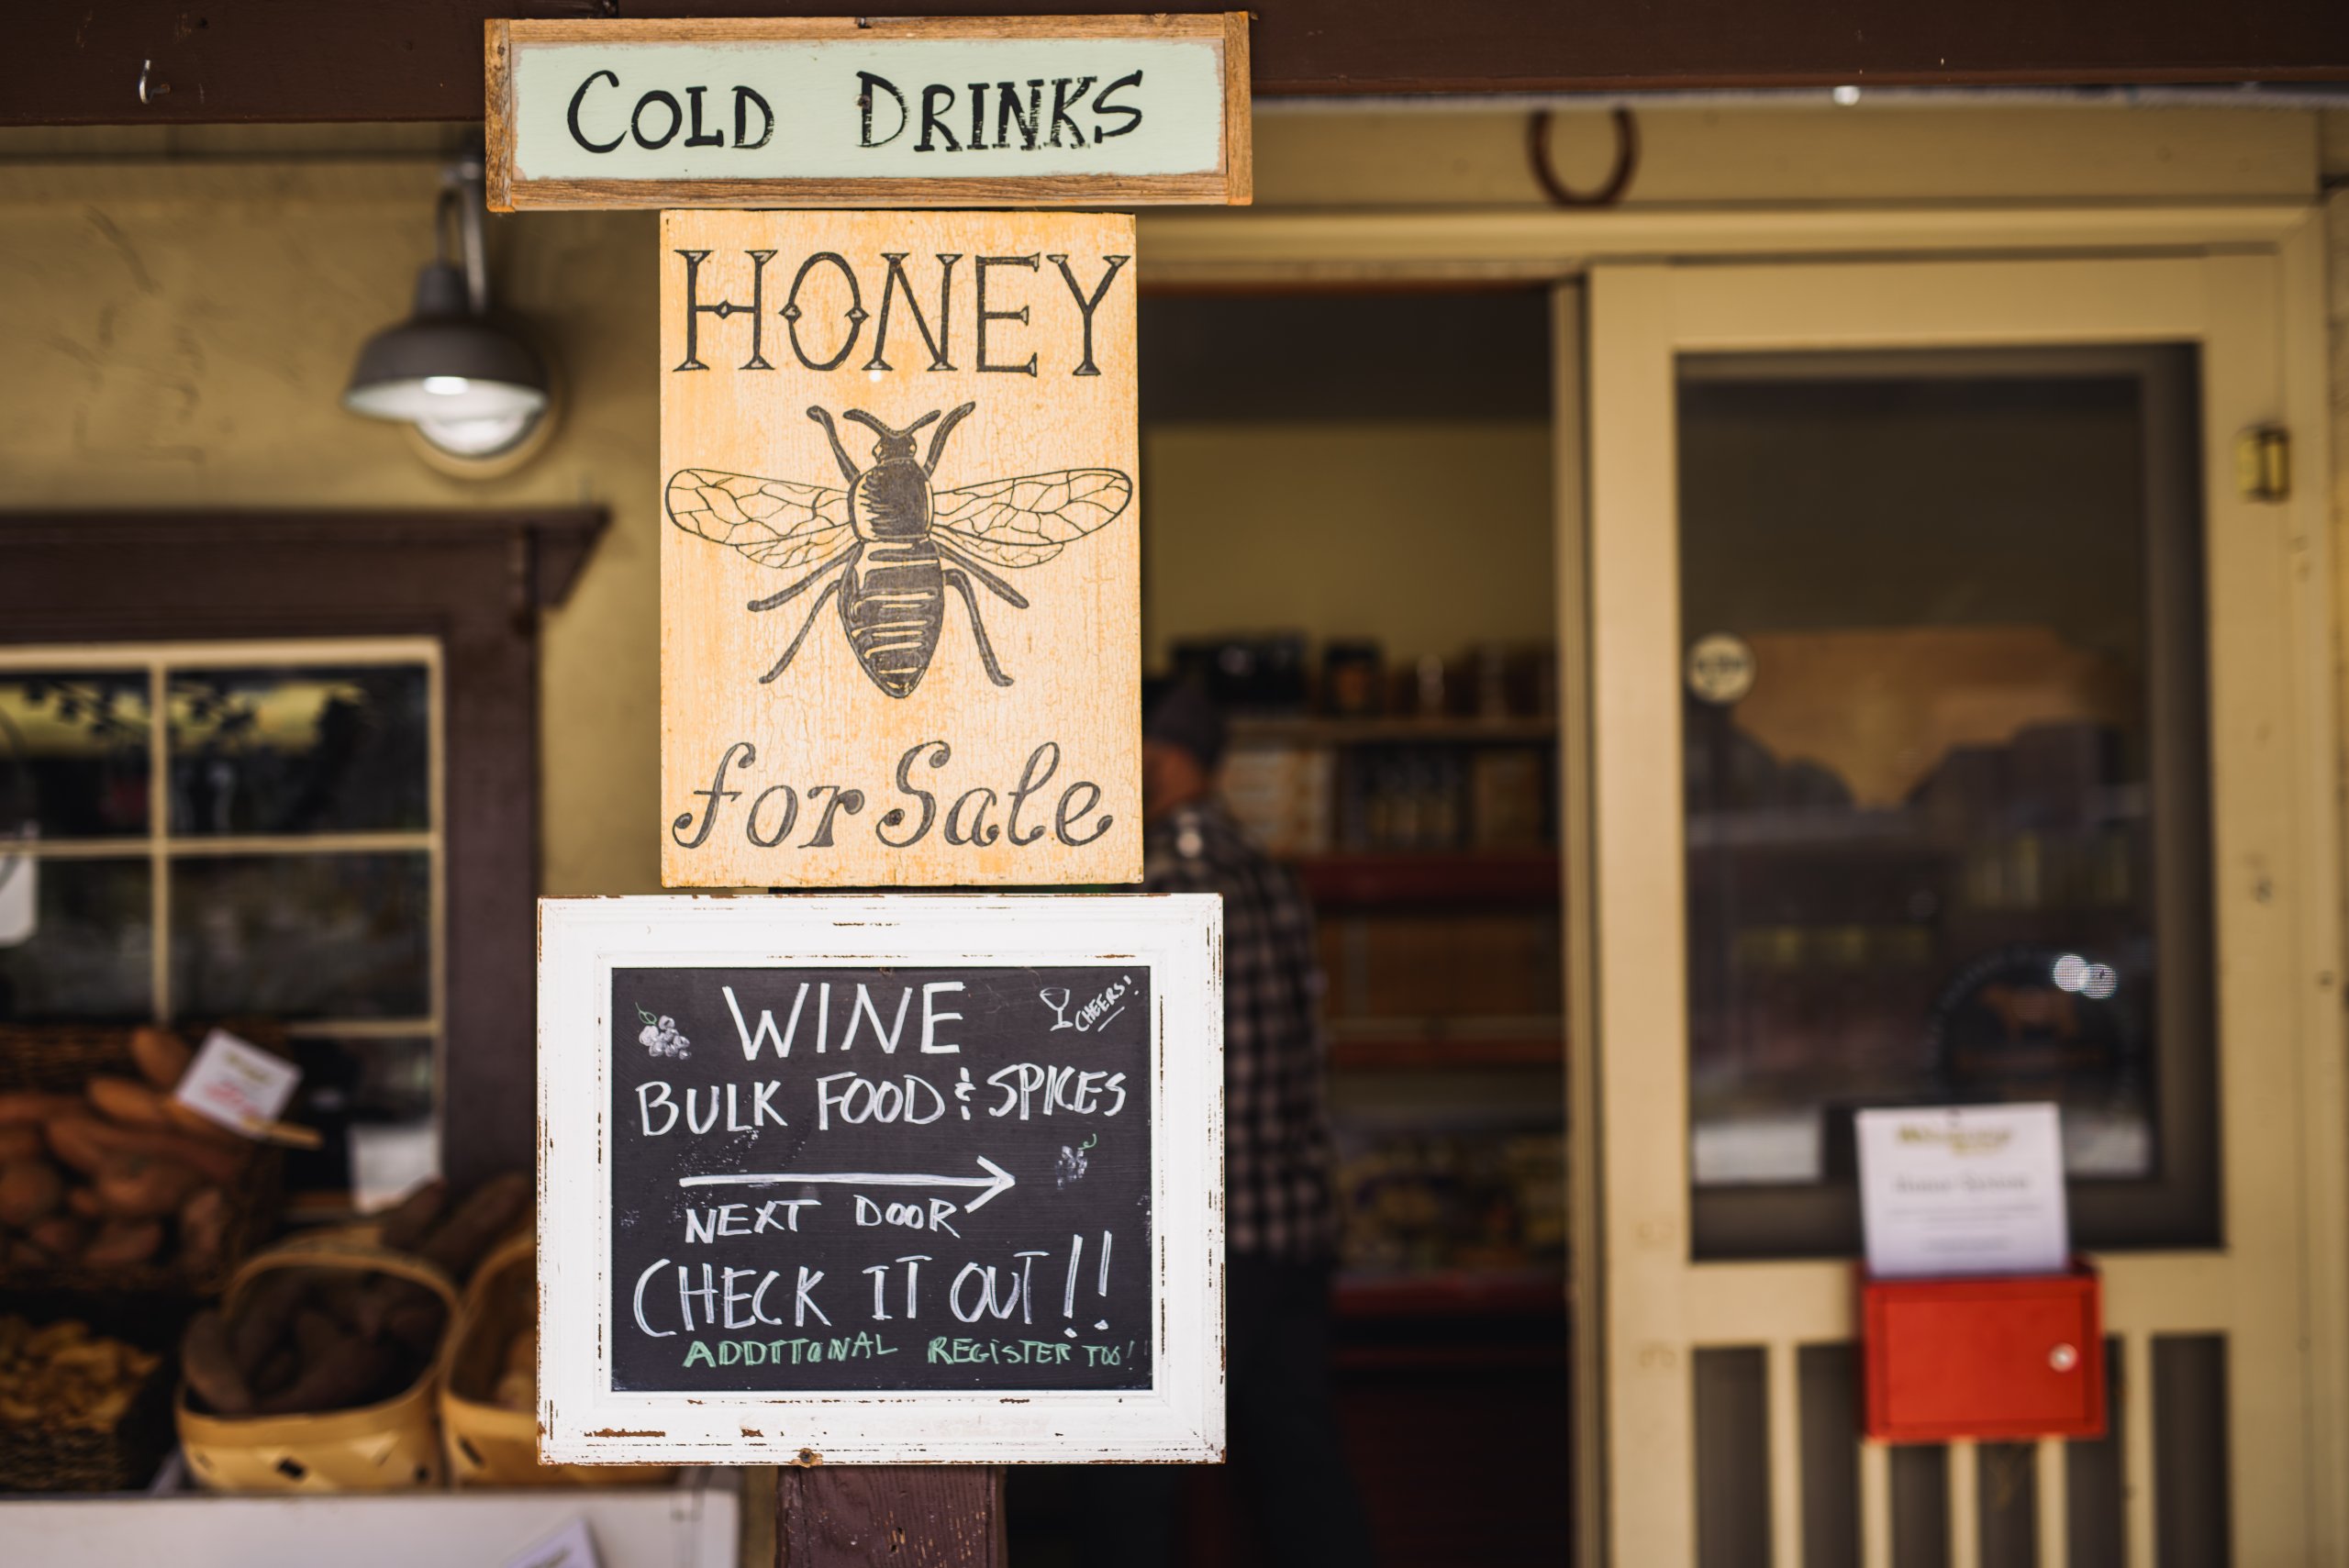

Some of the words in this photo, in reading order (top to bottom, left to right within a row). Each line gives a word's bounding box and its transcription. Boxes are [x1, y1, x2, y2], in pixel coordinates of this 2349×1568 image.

[567, 70, 775, 153] COLD
[855, 70, 1144, 152] DRINKS
[672, 249, 1132, 376] HONEY
[672, 741, 865, 849] for
[875, 740, 1114, 848] Sale
[722, 981, 965, 1061] WINE
[1074, 974, 1140, 1032] CHEERS!
[635, 1079, 788, 1136] BULK
[817, 1070, 945, 1130] FOOD
[986, 1062, 1127, 1121] SPICES
[685, 1199, 821, 1244] NEXT
[853, 1195, 961, 1239] DOOR
[633, 1258, 831, 1337] CHECK
[863, 1255, 932, 1320] IT
